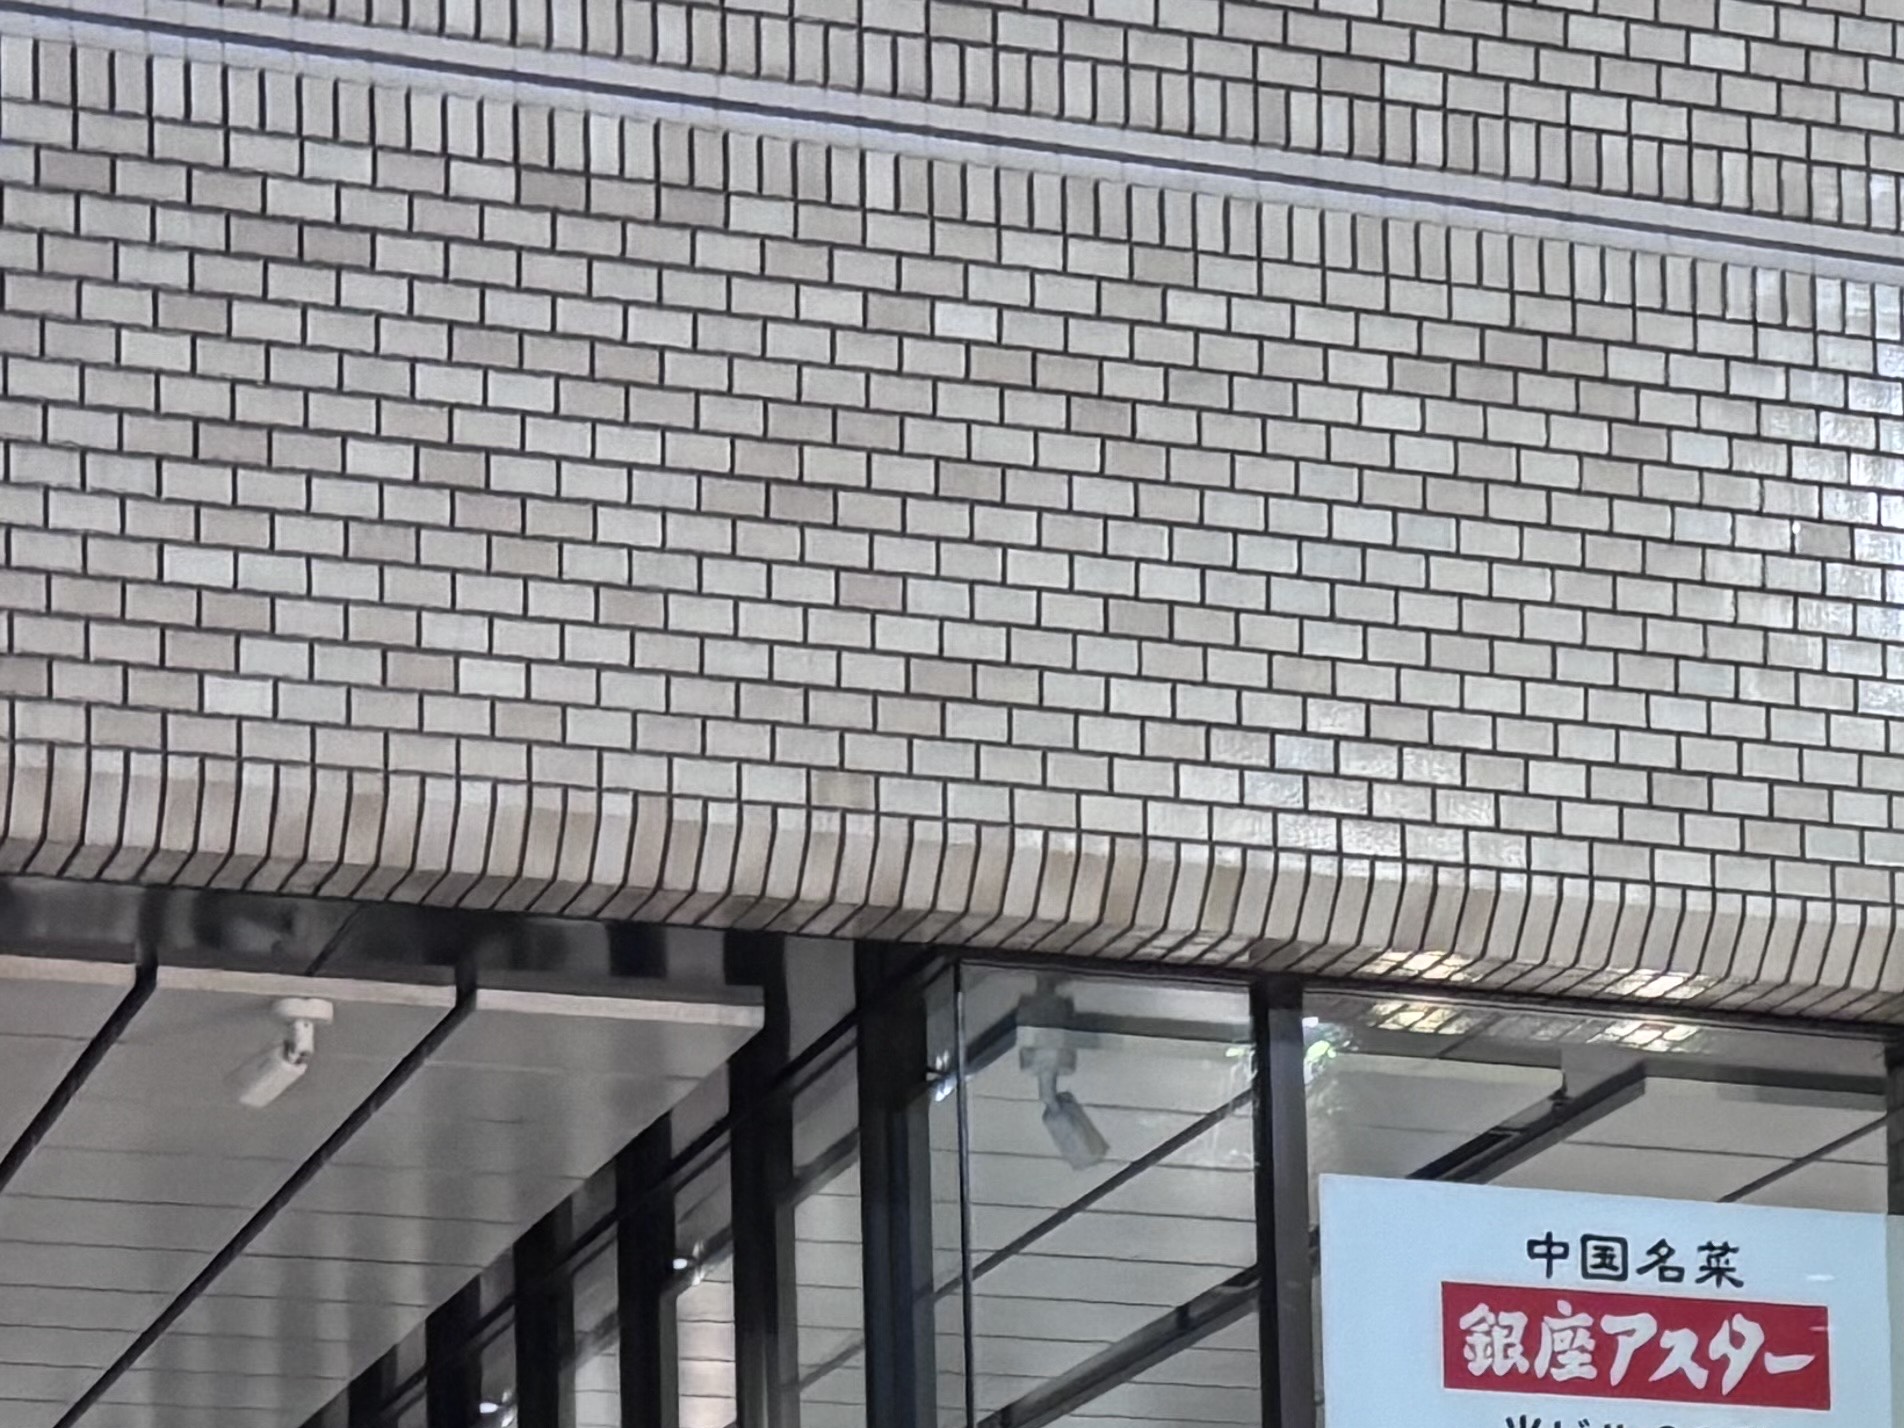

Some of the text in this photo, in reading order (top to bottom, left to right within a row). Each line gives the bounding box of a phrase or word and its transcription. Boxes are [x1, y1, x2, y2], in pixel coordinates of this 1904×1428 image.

[1525, 1231, 1745, 1289] 中国名菜
[1458, 1299, 1816, 1395] 銀座アスター
